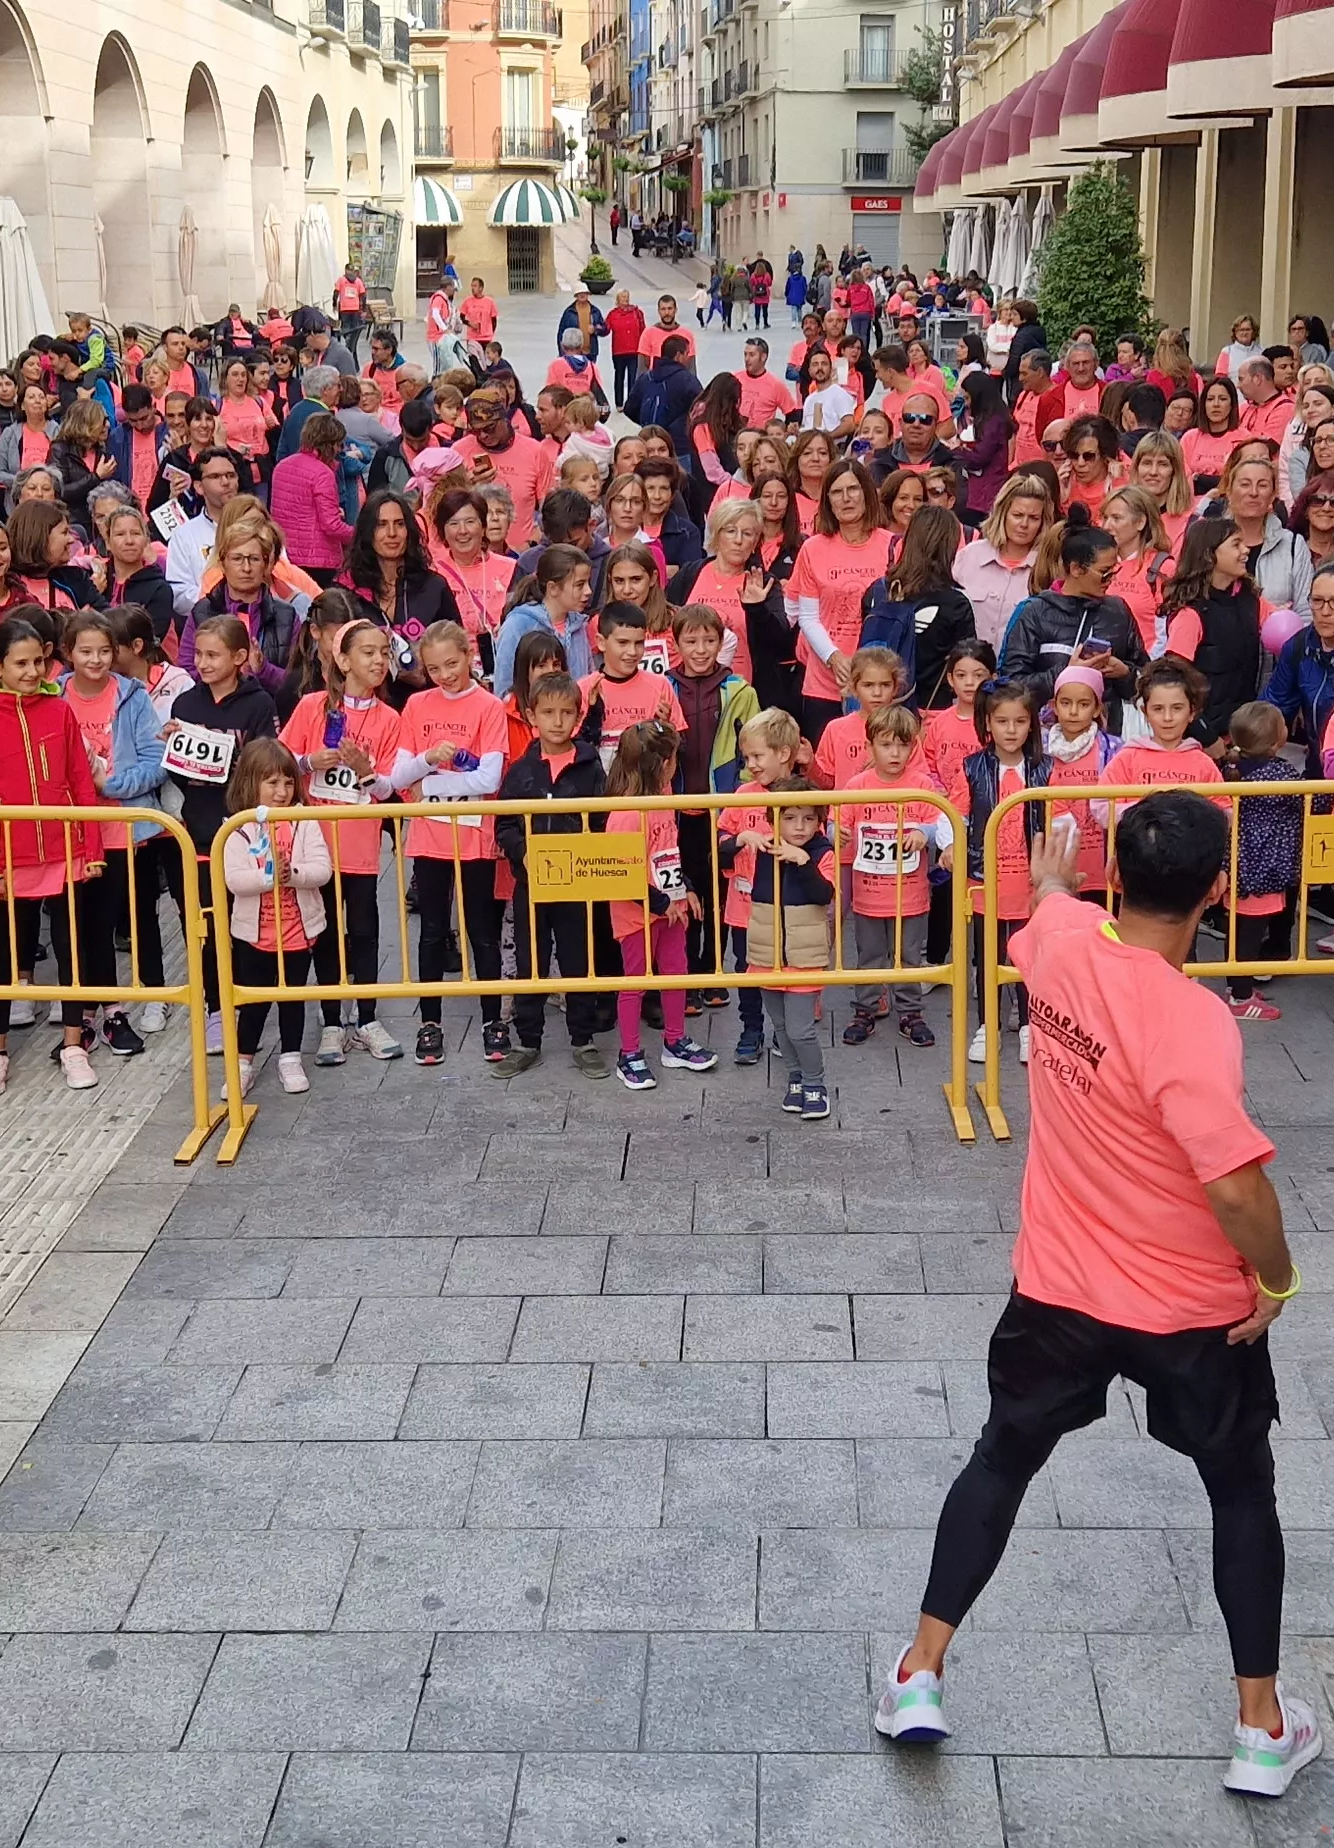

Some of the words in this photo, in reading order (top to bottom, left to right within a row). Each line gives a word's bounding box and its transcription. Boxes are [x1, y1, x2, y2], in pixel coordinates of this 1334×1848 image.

[941, 7, 955, 102] HOSTAL
[865, 199, 888, 209] GAES
[612, 707, 647, 716] CÁNCER
[435, 722, 467, 732] CÁNCER
[173, 734, 223, 764] 1619
[1159, 770, 1197, 782] CÁNCER
[575, 856, 643, 868] Ayuntamiento
[575, 868, 587, 877] de
[589, 868, 627, 878] Huesca
